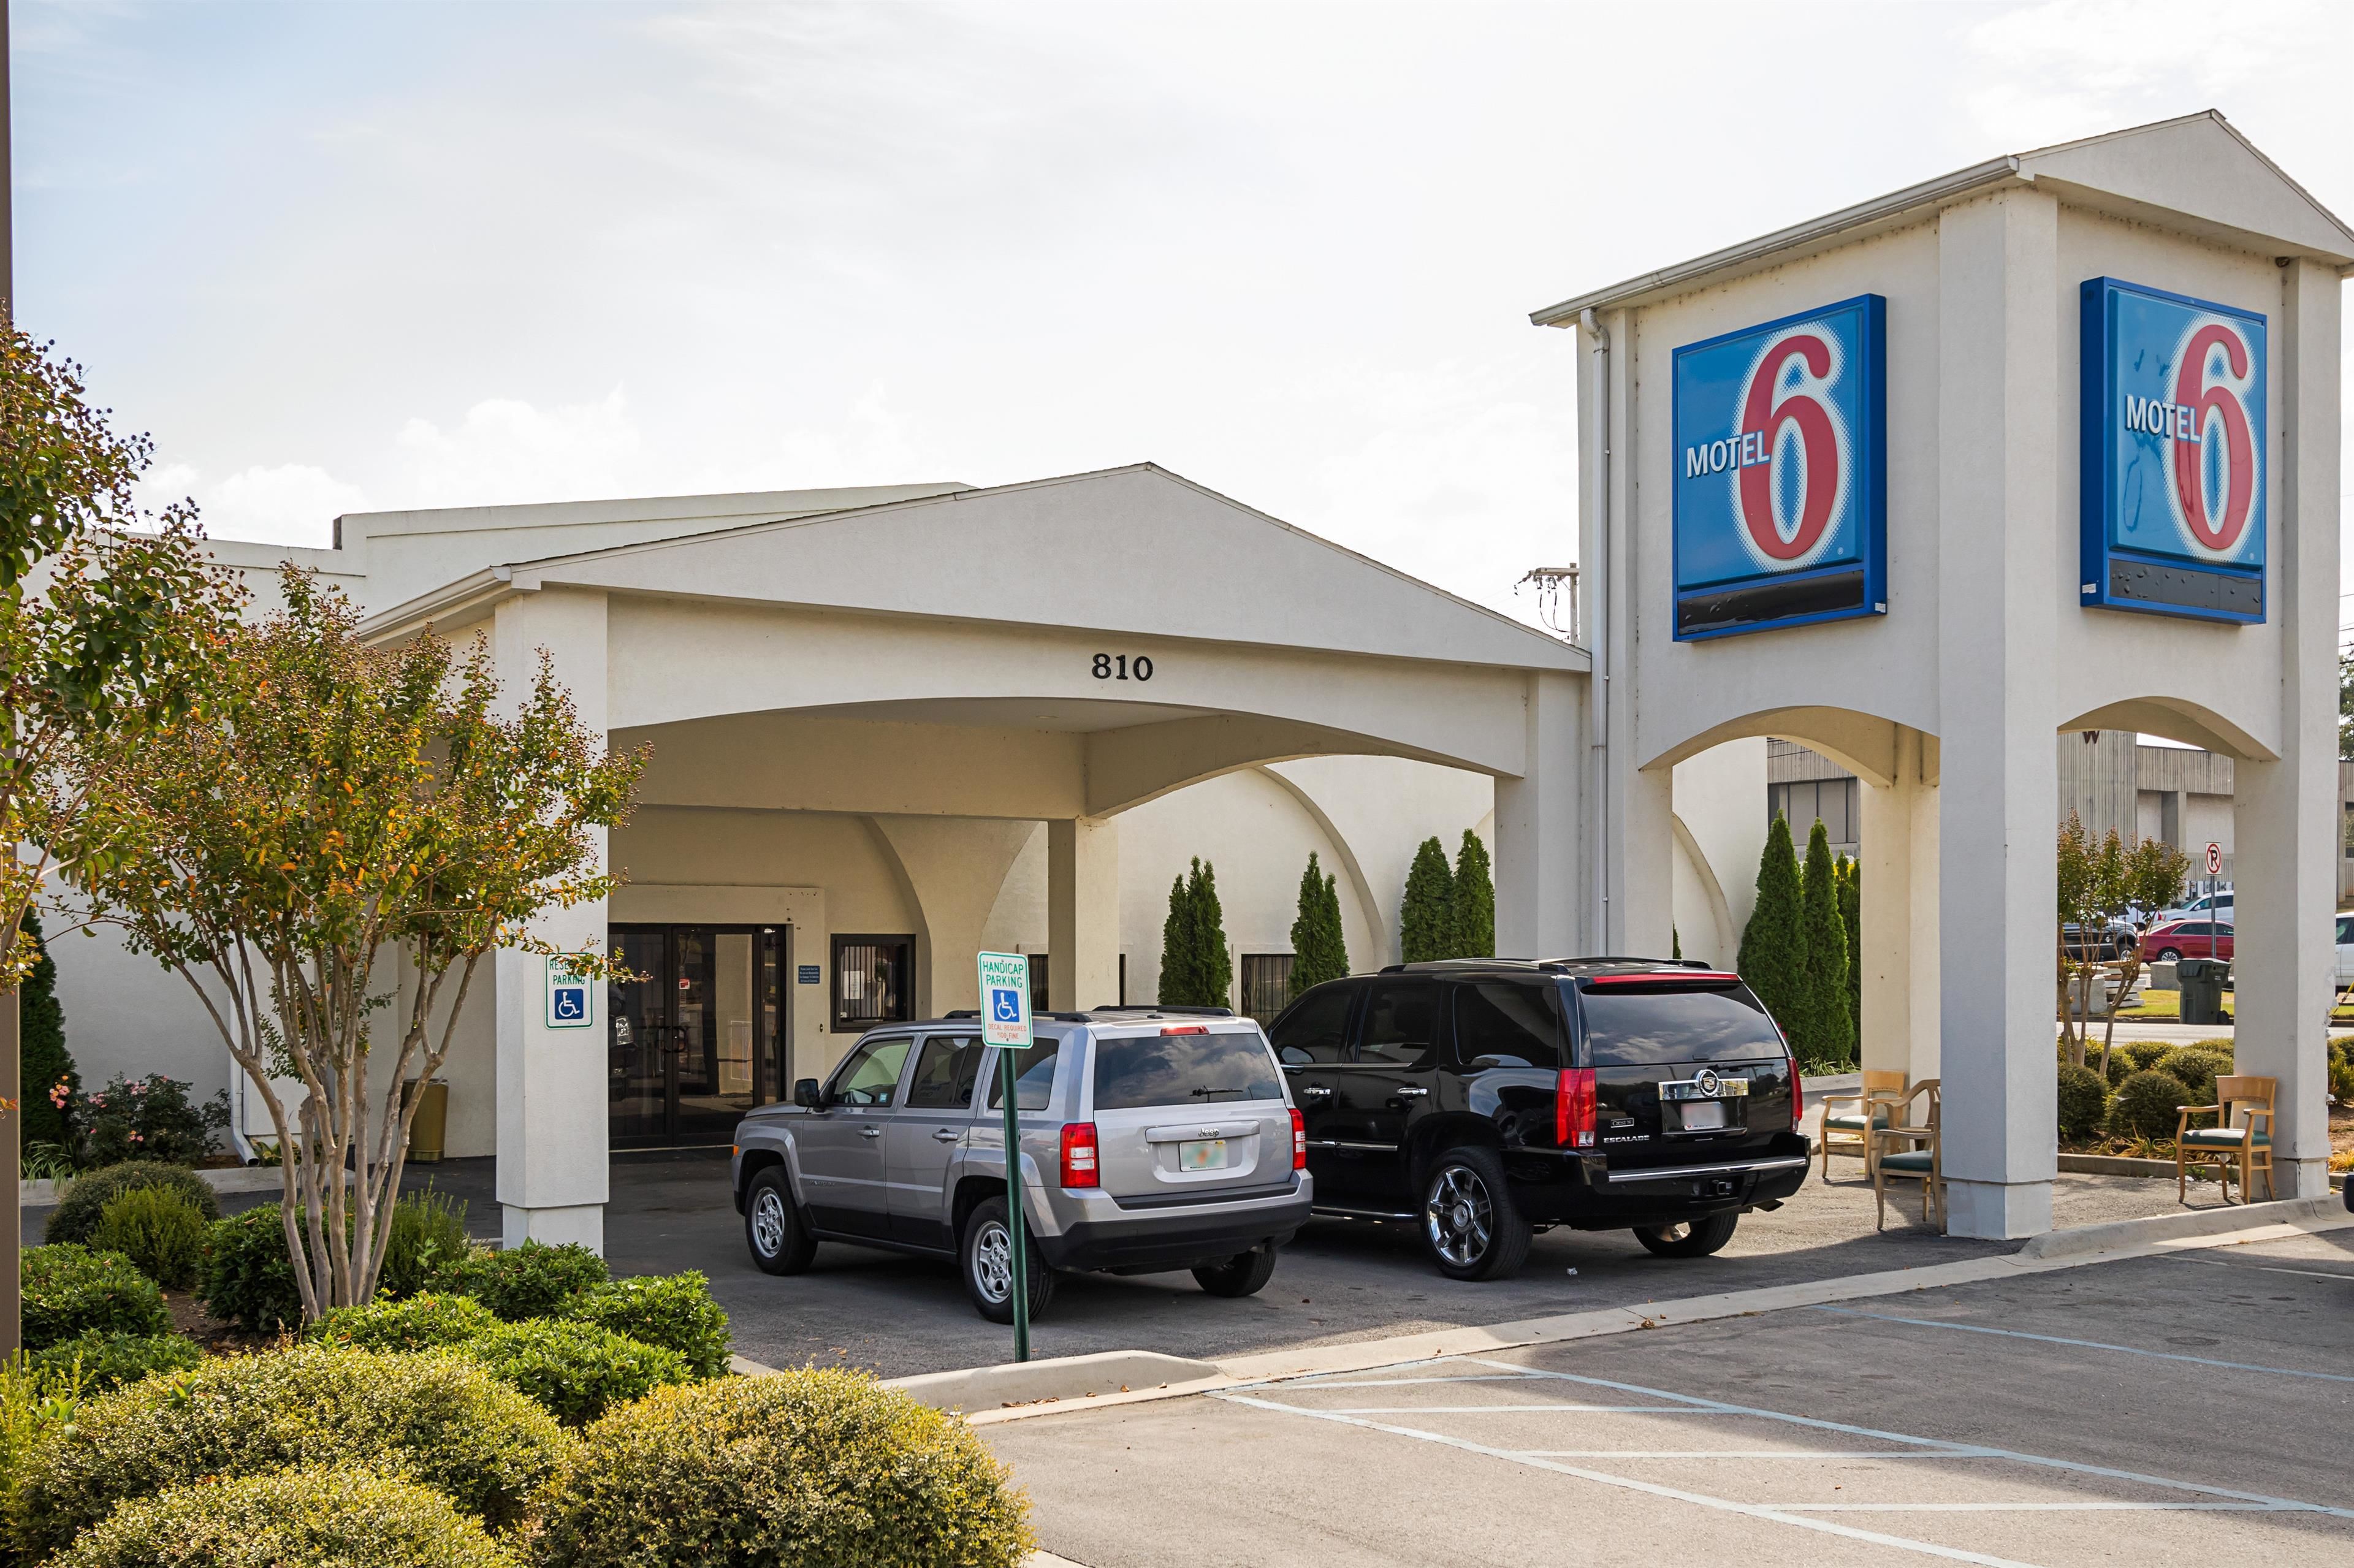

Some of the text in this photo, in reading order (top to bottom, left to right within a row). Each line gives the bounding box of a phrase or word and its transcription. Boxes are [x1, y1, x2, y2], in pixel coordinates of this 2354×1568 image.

[2125, 324, 2253, 551] MOTEL 6
[1686, 335, 1838, 560] MOTEL 6
[1091, 653, 1154, 682] 810
[983, 961, 1024, 975] HANDICAP
[553, 975, 585, 985] PARKING
[986, 975, 1023, 988] PARKING
[1198, 1127, 1220, 1138] Jeep
